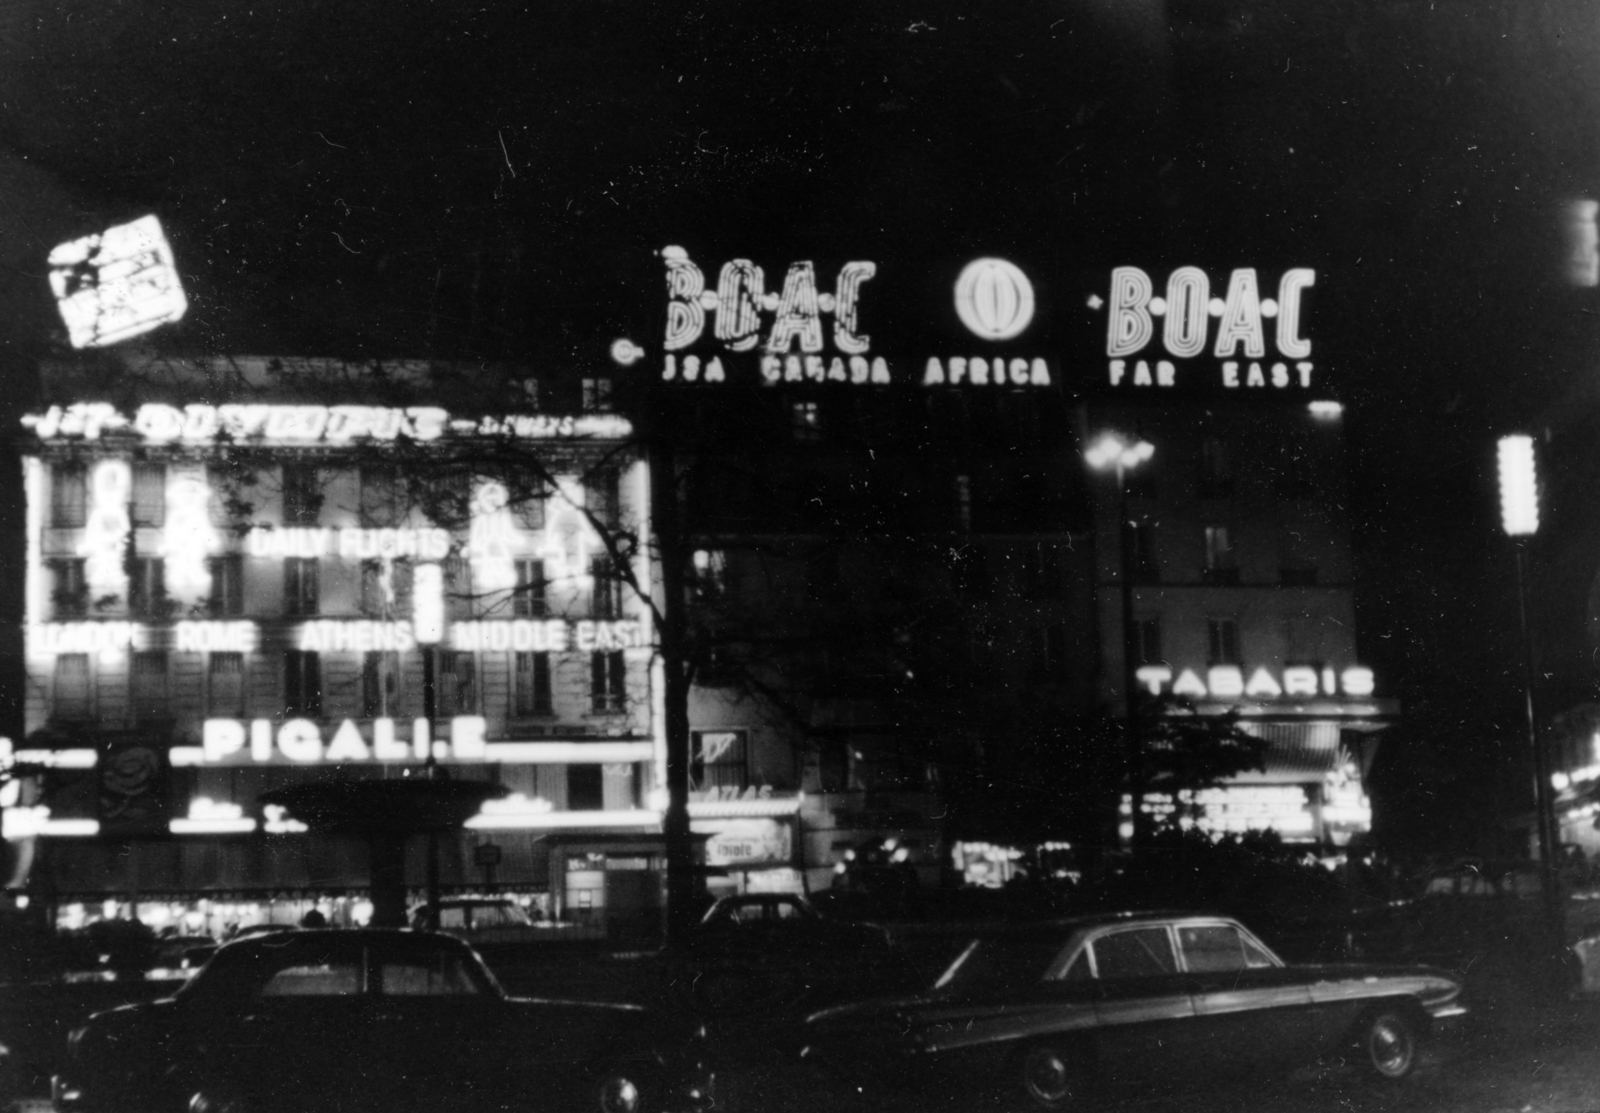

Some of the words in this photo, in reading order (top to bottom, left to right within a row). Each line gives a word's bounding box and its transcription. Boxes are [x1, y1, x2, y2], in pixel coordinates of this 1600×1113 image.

[923, 356, 1051, 386] AFRICA
[1109, 359, 1175, 386] FAR
[1222, 361, 1314, 388] EAST
[249, 527, 329, 558] DAILY
[339, 528, 450, 559] FLIGHTS
[175, 620, 257, 652] ROME
[299, 620, 413, 652] ATHENS
[455, 620, 565, 652] MIDDLE
[1135, 665, 1375, 696] TABARIS
[703, 785, 773, 802] ATLAS
